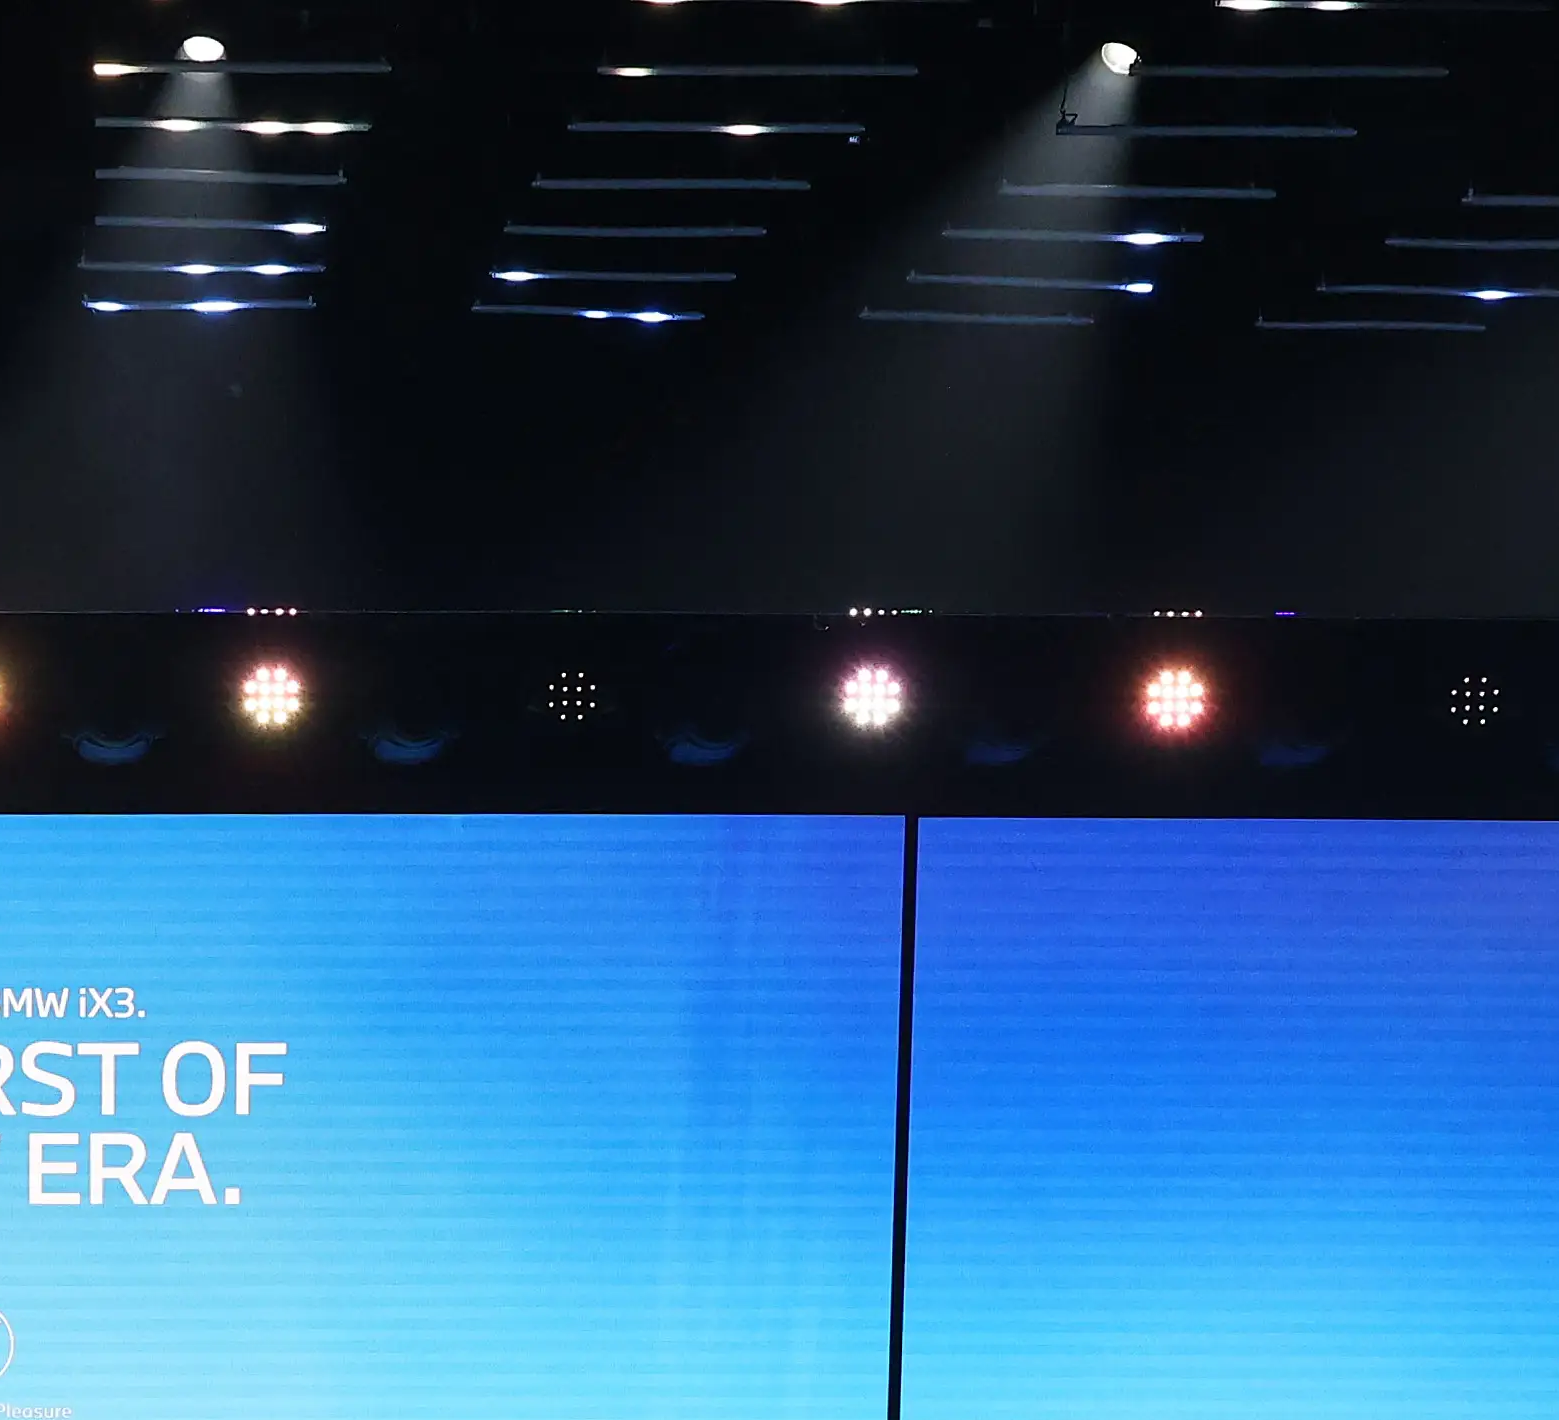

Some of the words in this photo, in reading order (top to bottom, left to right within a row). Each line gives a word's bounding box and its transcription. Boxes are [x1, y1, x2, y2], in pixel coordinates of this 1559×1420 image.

[79, 987, 146, 1019] iX3.
[162, 1041, 287, 1117] OF
[28, 1132, 241, 1206] ERA.
